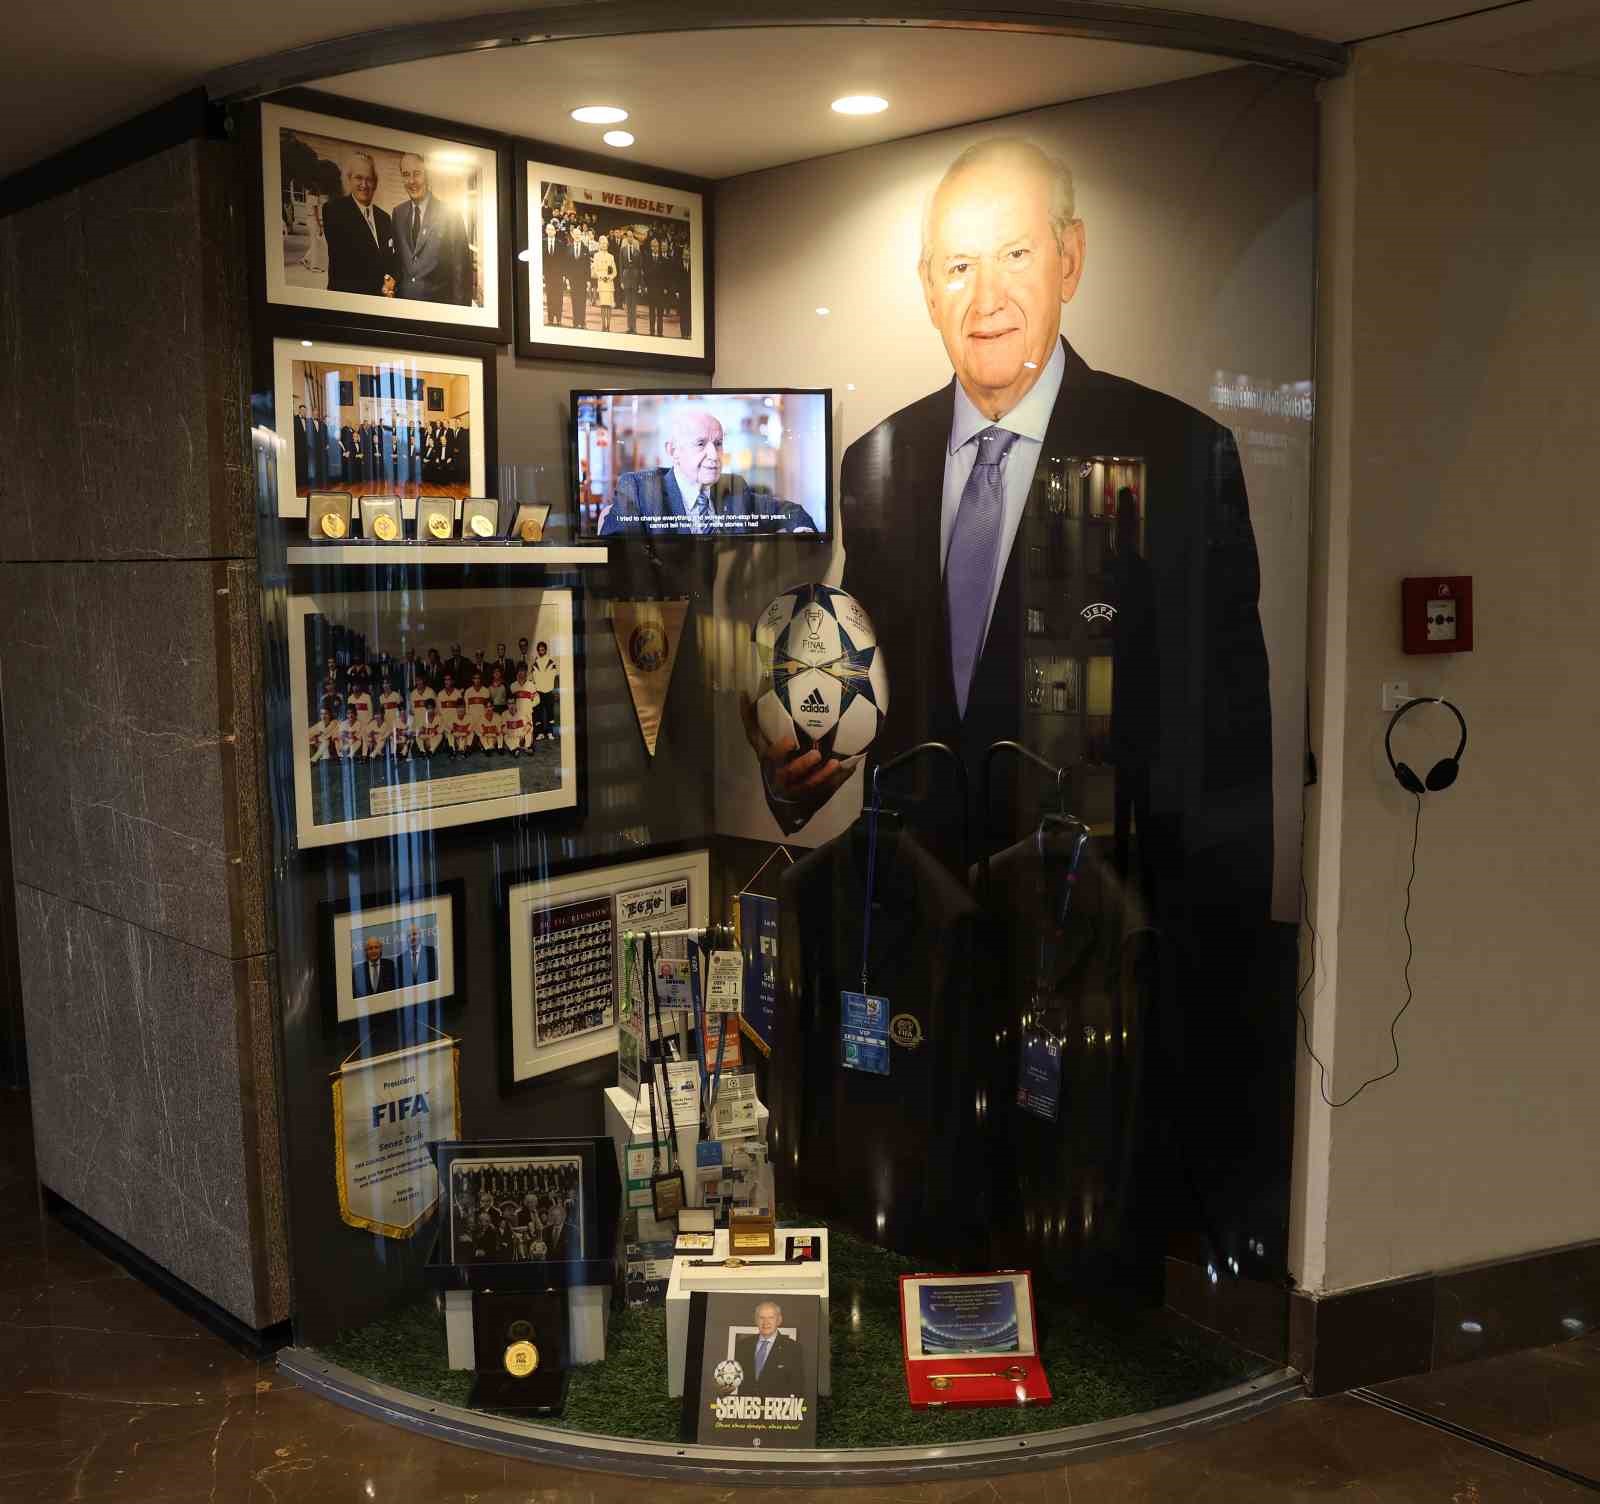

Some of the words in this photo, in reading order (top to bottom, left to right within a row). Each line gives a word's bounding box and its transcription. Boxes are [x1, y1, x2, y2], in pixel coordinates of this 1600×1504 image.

[602, 191, 674, 214] WEMBLEY
[725, 513, 750, 521] non-stop
[1083, 606, 1113, 618] UEFA
[802, 640, 826, 650] FINAL
[800, 704, 830, 713] adidas
[372, 1093, 430, 1128] FIFA
